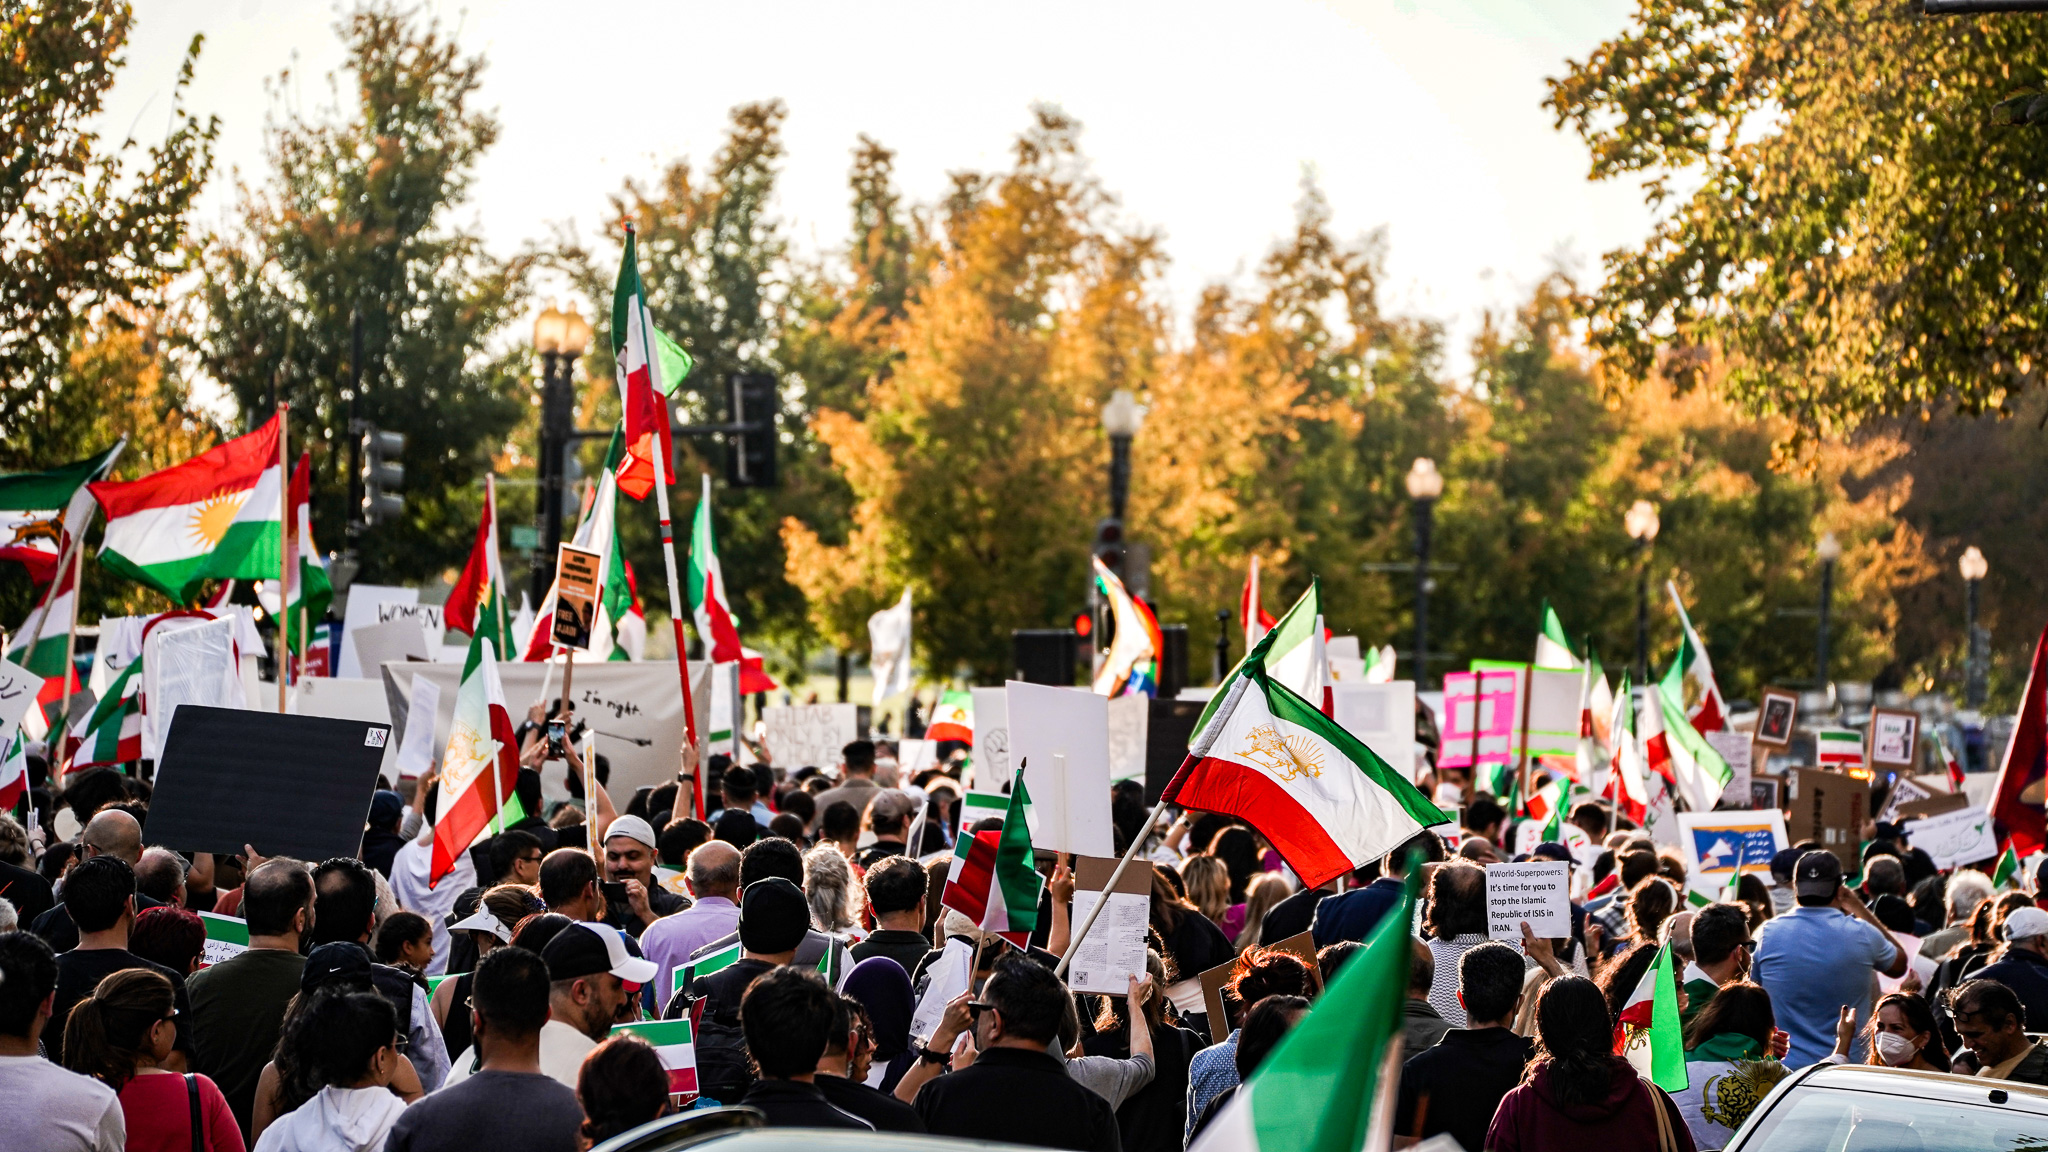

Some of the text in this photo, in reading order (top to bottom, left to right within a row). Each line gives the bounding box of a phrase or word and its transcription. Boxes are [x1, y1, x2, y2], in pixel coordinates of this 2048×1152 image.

[557, 609, 573, 622] FREE
[582, 690, 643, 719] I'm right.
[1490, 869, 1563, 878] #World-Superpowers:
[1490, 884, 1501, 892] It's
[1503, 884, 1519, 892] time
[1520, 883, 1531, 891] for
[1532, 884, 1546, 892] you
[1491, 896, 1547, 907] stop the Islamic
[1491, 909, 1554, 920] Republic of ISIS in
[1492, 924, 1513, 932] IRAN.
